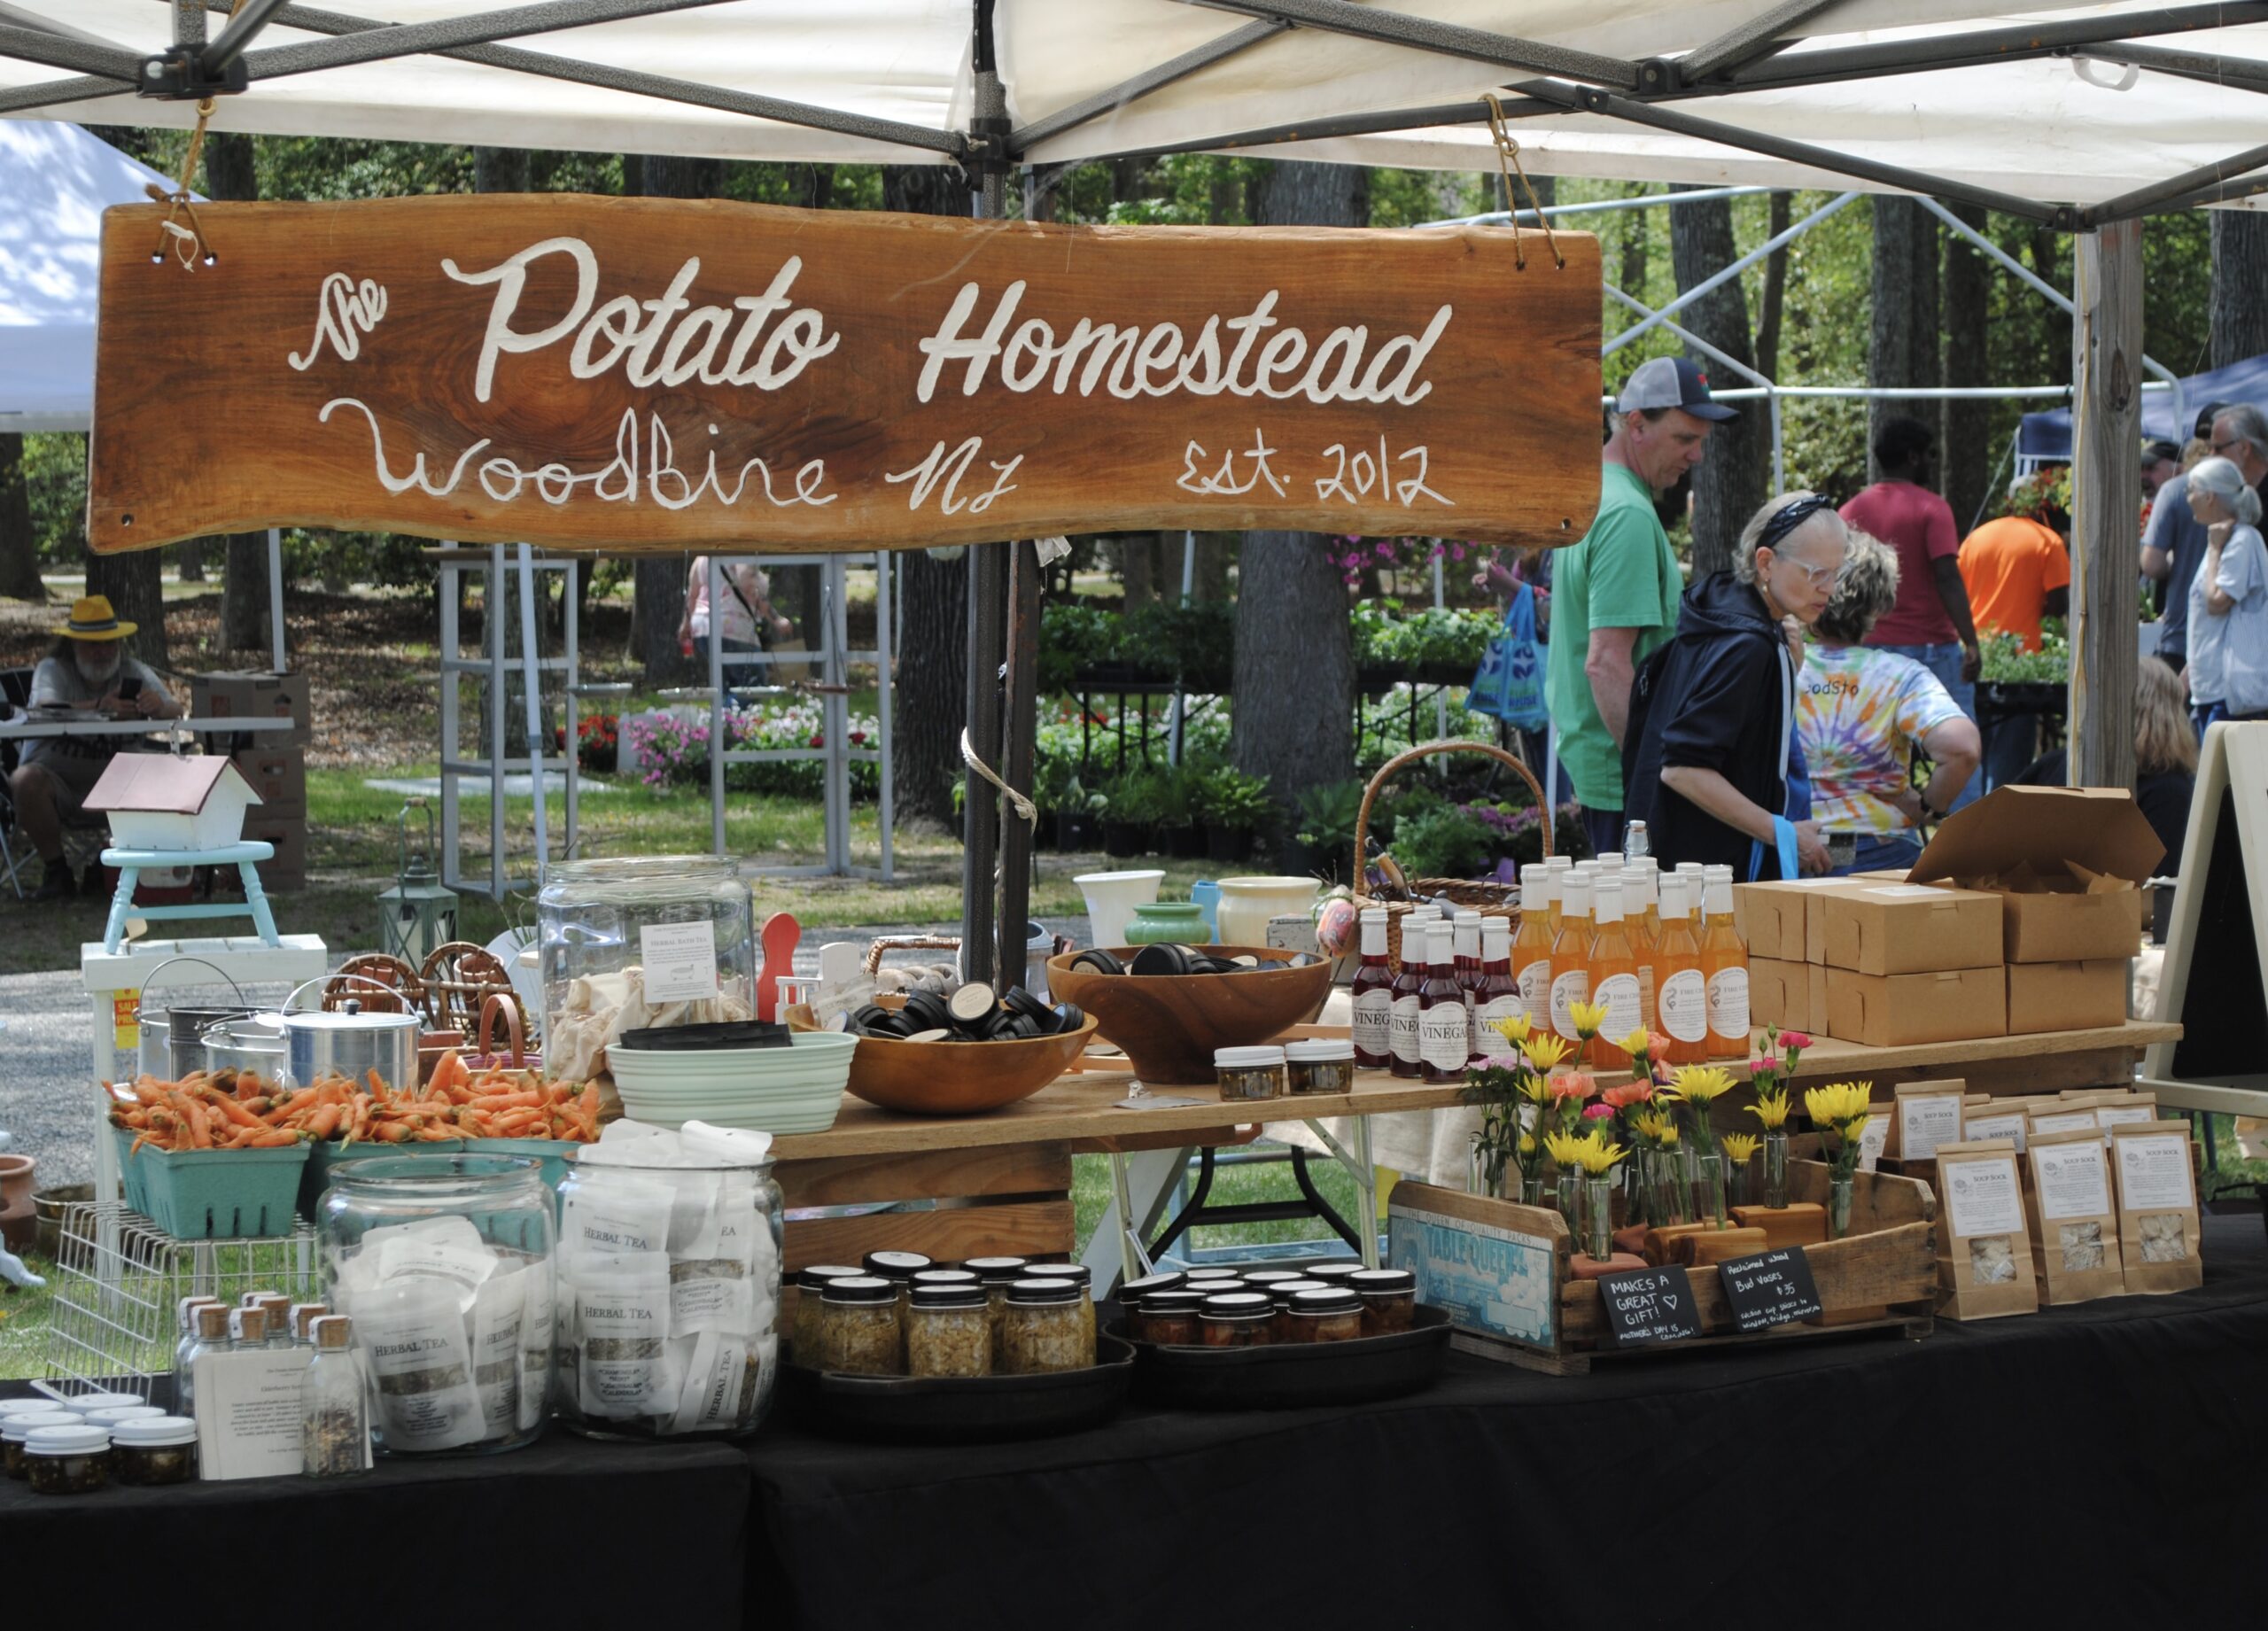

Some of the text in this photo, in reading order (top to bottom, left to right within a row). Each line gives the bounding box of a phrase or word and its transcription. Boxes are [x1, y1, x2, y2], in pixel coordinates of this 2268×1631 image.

[289, 236, 1453, 406] The Potato Homestead
[319, 397, 1456, 515] Woodbine NJ Est. 2012
[721, 1226, 736, 1237] EA
[1408, 1209, 1420, 1219] THE
[1425, 1213, 1450, 1227] QUEEN
[1455, 1221, 1465, 1231] OF
[1471, 1223, 1502, 1237] QUALITY
[584, 1225, 648, 1249] HERBAL TEA
[1425, 1225, 1466, 1264] TABLE
[1727, 1259, 1765, 1275] Reclaimed
[1610, 1275, 1669, 1294] MAKES A
[1735, 1278, 1754, 1293] Bud
[1616, 1293, 1658, 1311] GREAT
[585, 1307, 653, 1319] HERBAL TEA
[1625, 1306, 1661, 1325] GIFT!
[1654, 1324, 1668, 1334] DAY
[1670, 1324, 1679, 1332] IS
[375, 1338, 449, 1356] HERBAL TEA
[705, 1349, 732, 1421] HERBAL TEA
